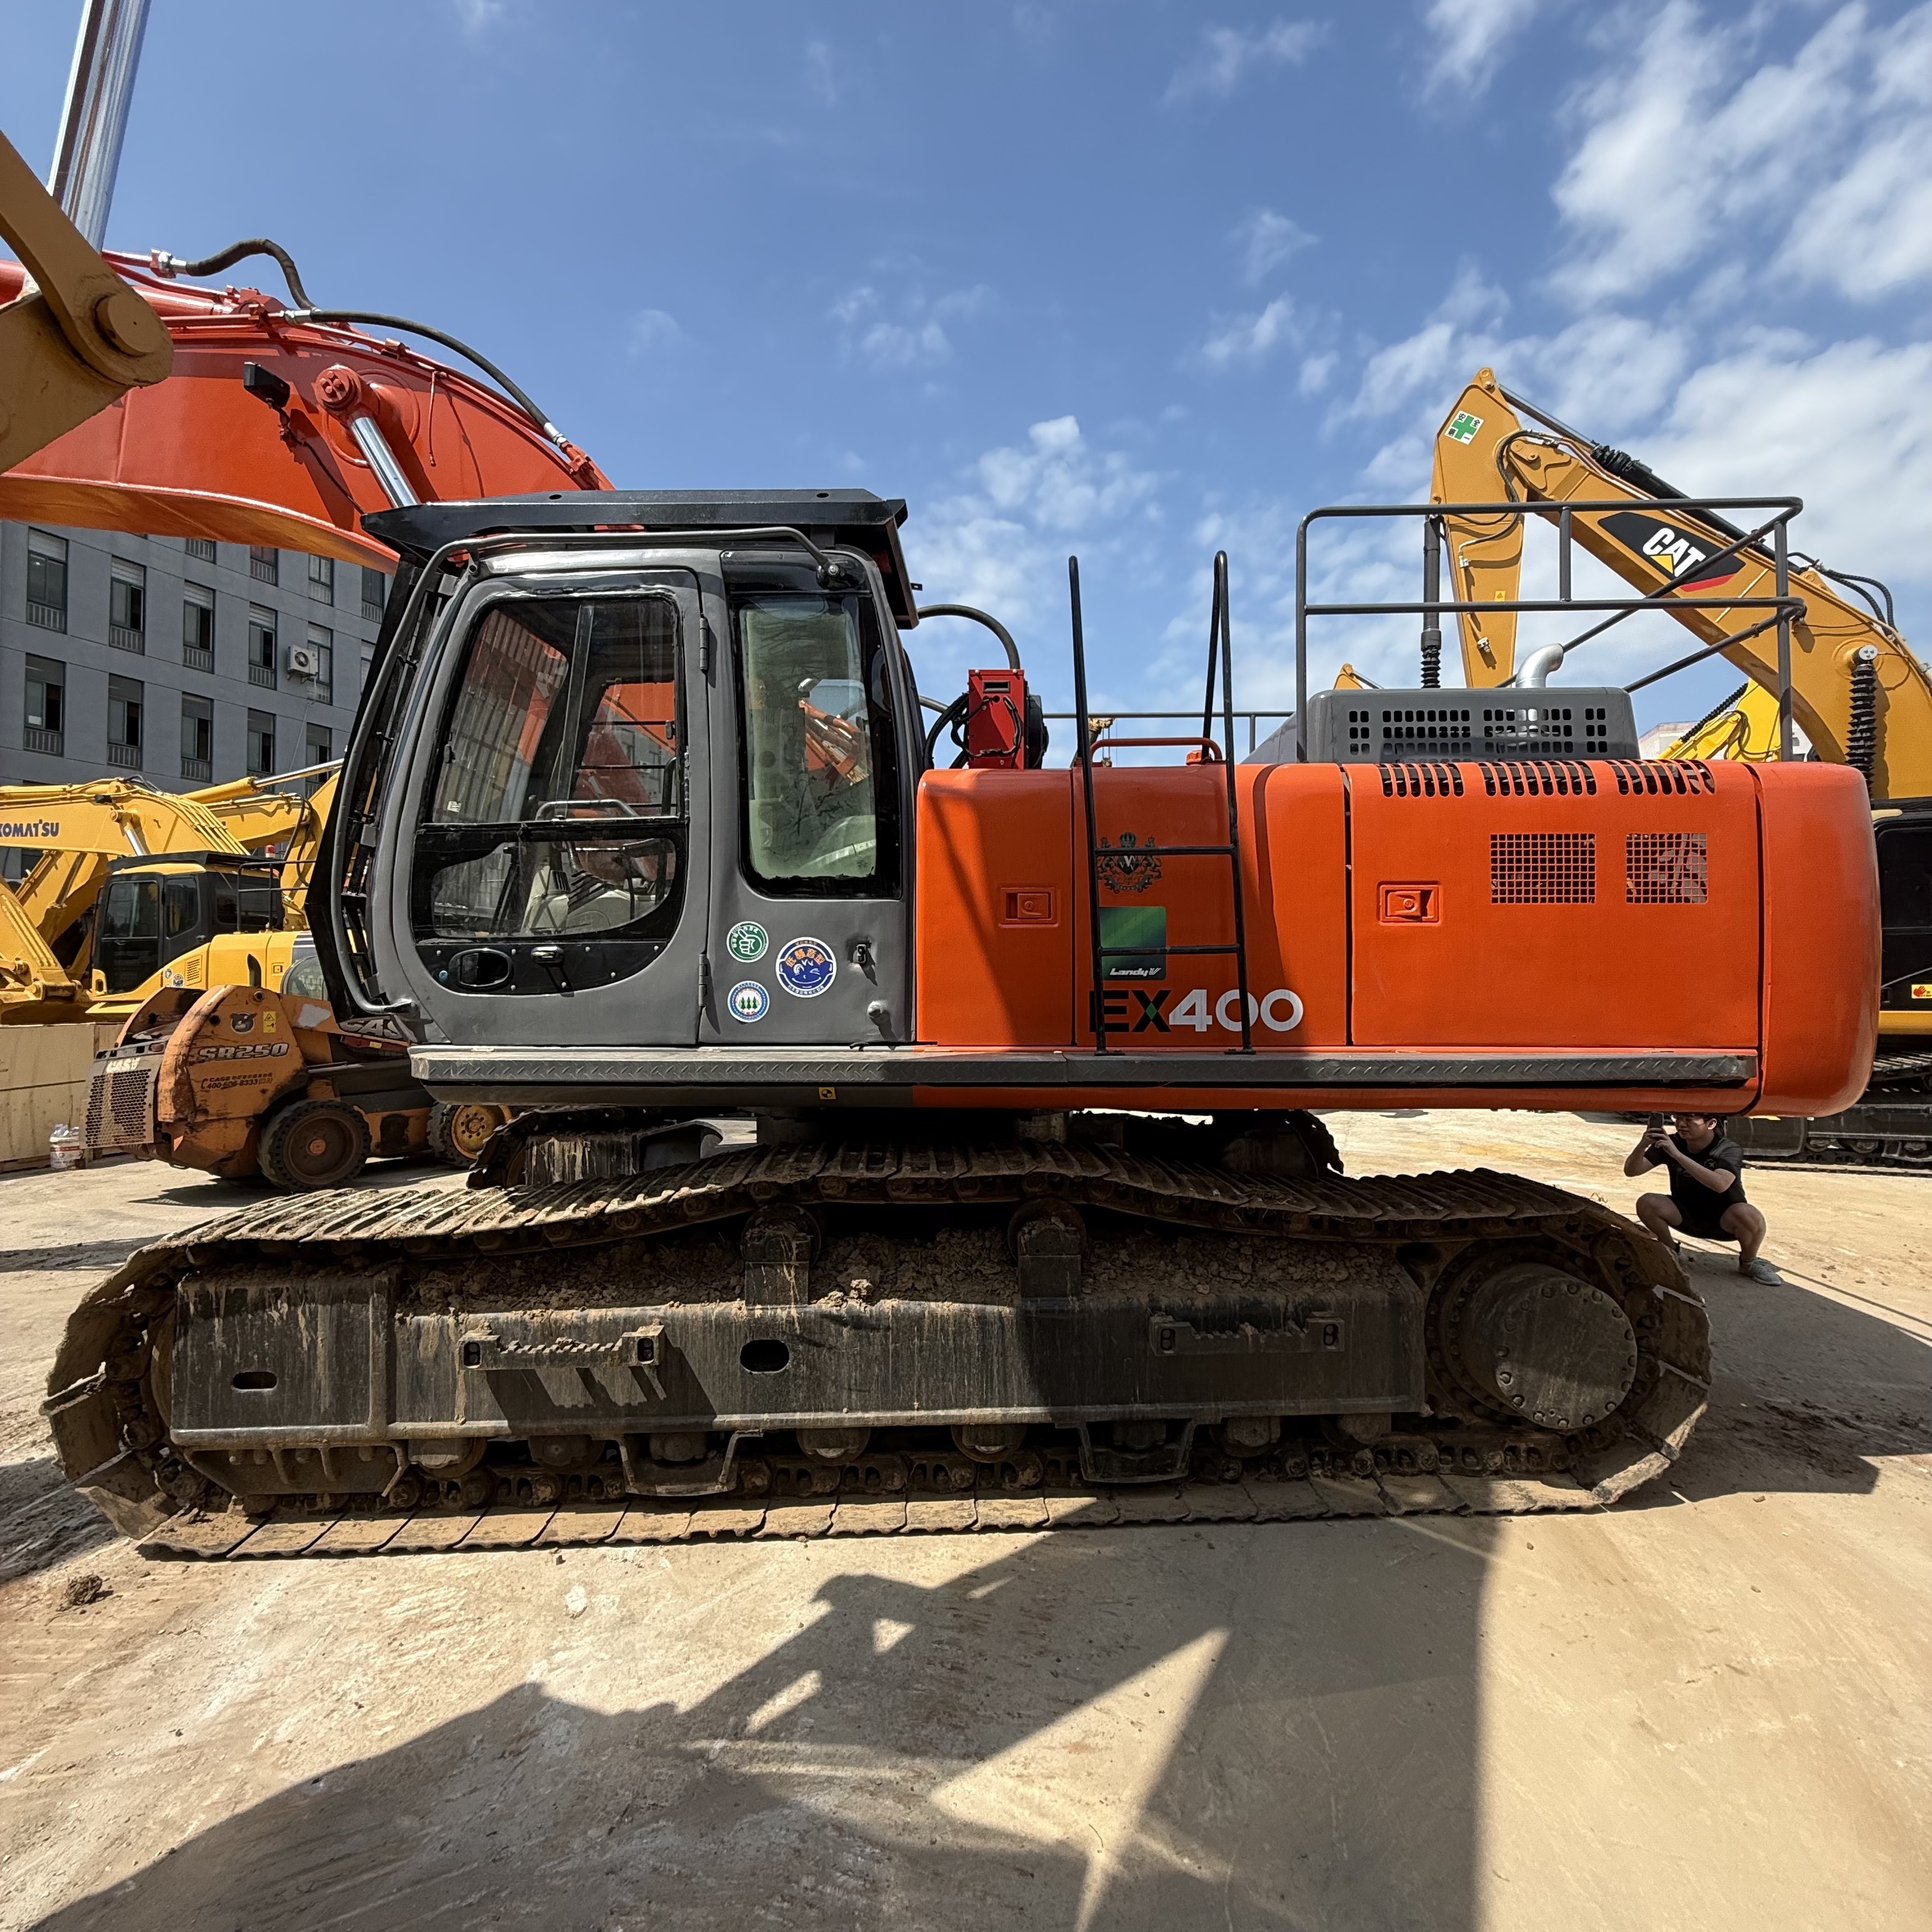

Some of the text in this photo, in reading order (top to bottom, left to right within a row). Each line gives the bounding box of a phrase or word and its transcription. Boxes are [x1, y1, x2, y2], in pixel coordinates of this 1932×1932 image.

[1643, 528, 1706, 578] CAT
[339, 1015, 404, 1039] CAS
[1089, 989, 1304, 1032] EX400
[197, 1043, 289, 1061] SR250
